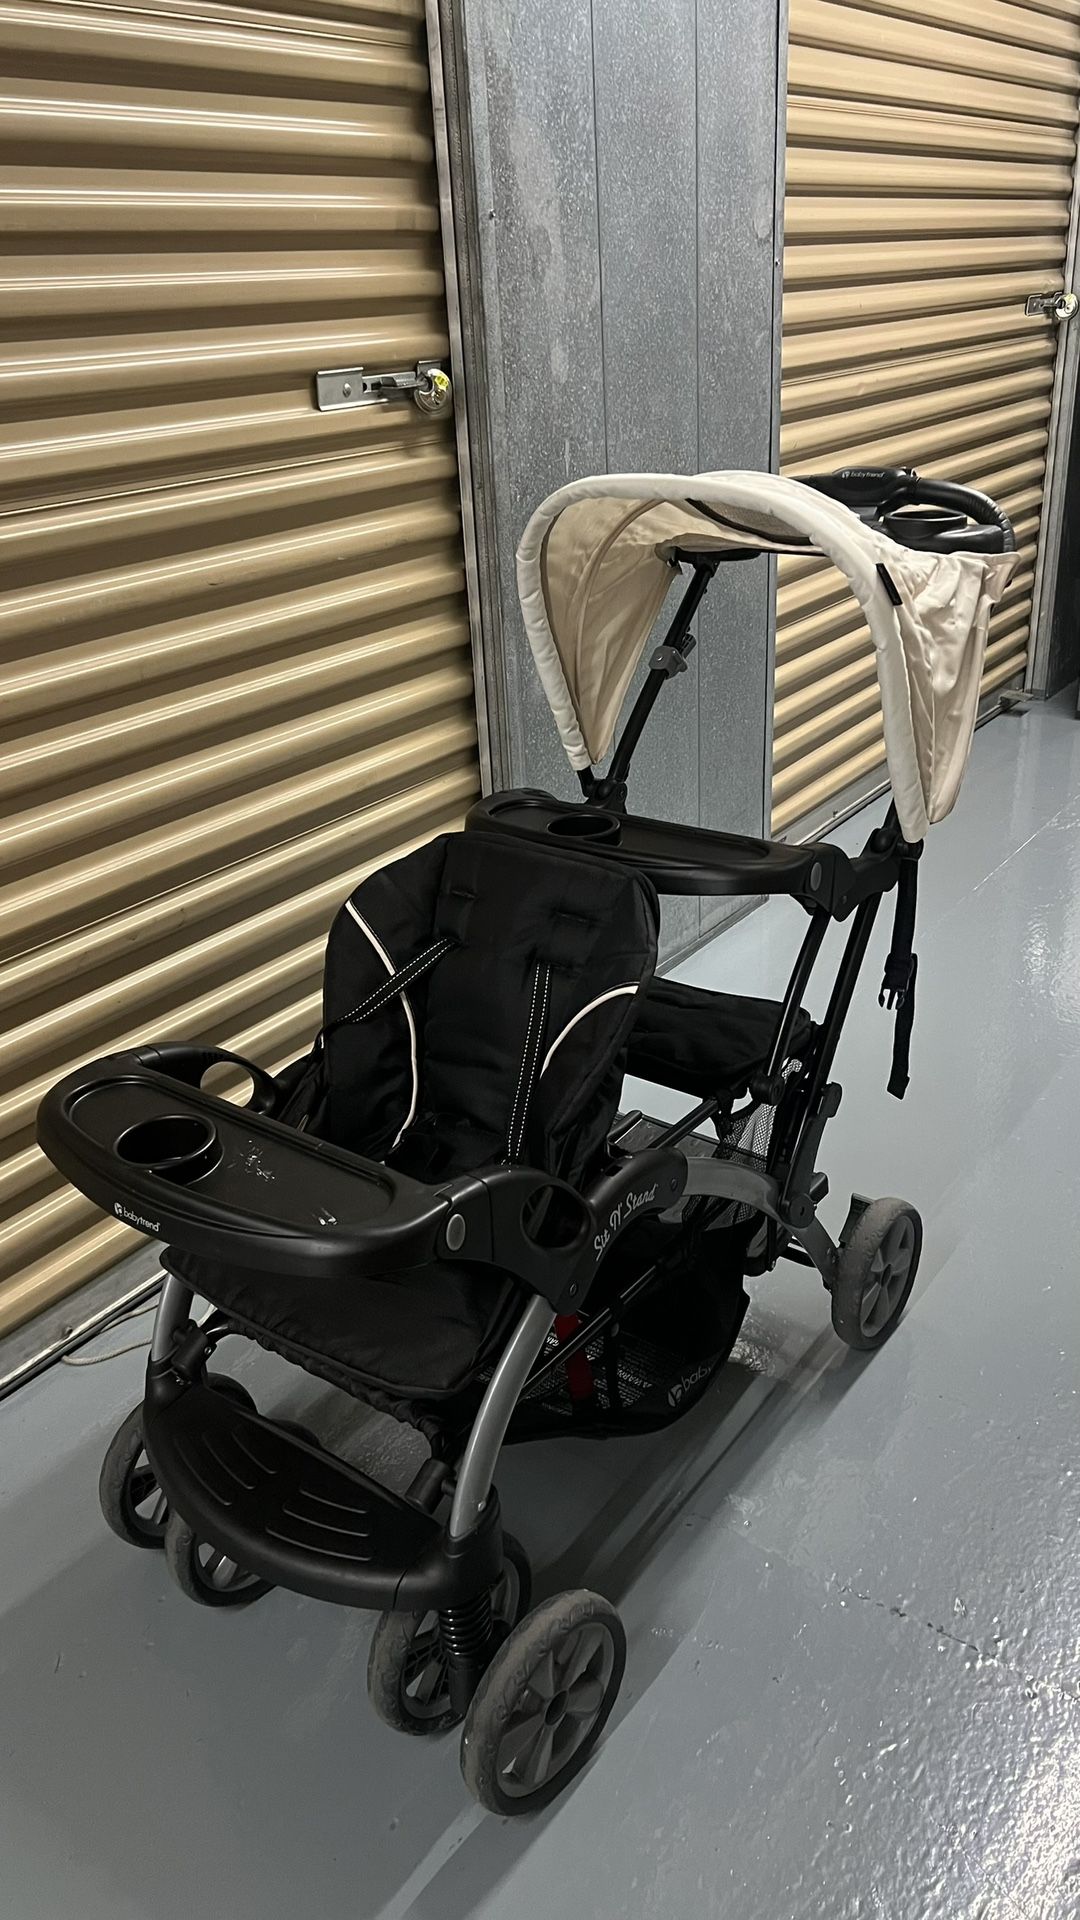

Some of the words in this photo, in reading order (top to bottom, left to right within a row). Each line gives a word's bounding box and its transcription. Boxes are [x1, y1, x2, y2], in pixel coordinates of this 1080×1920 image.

[123, 1206, 160, 1232] babytrend
[594, 1228, 611, 1261] Sit
[623, 1184, 657, 1219] Stand
